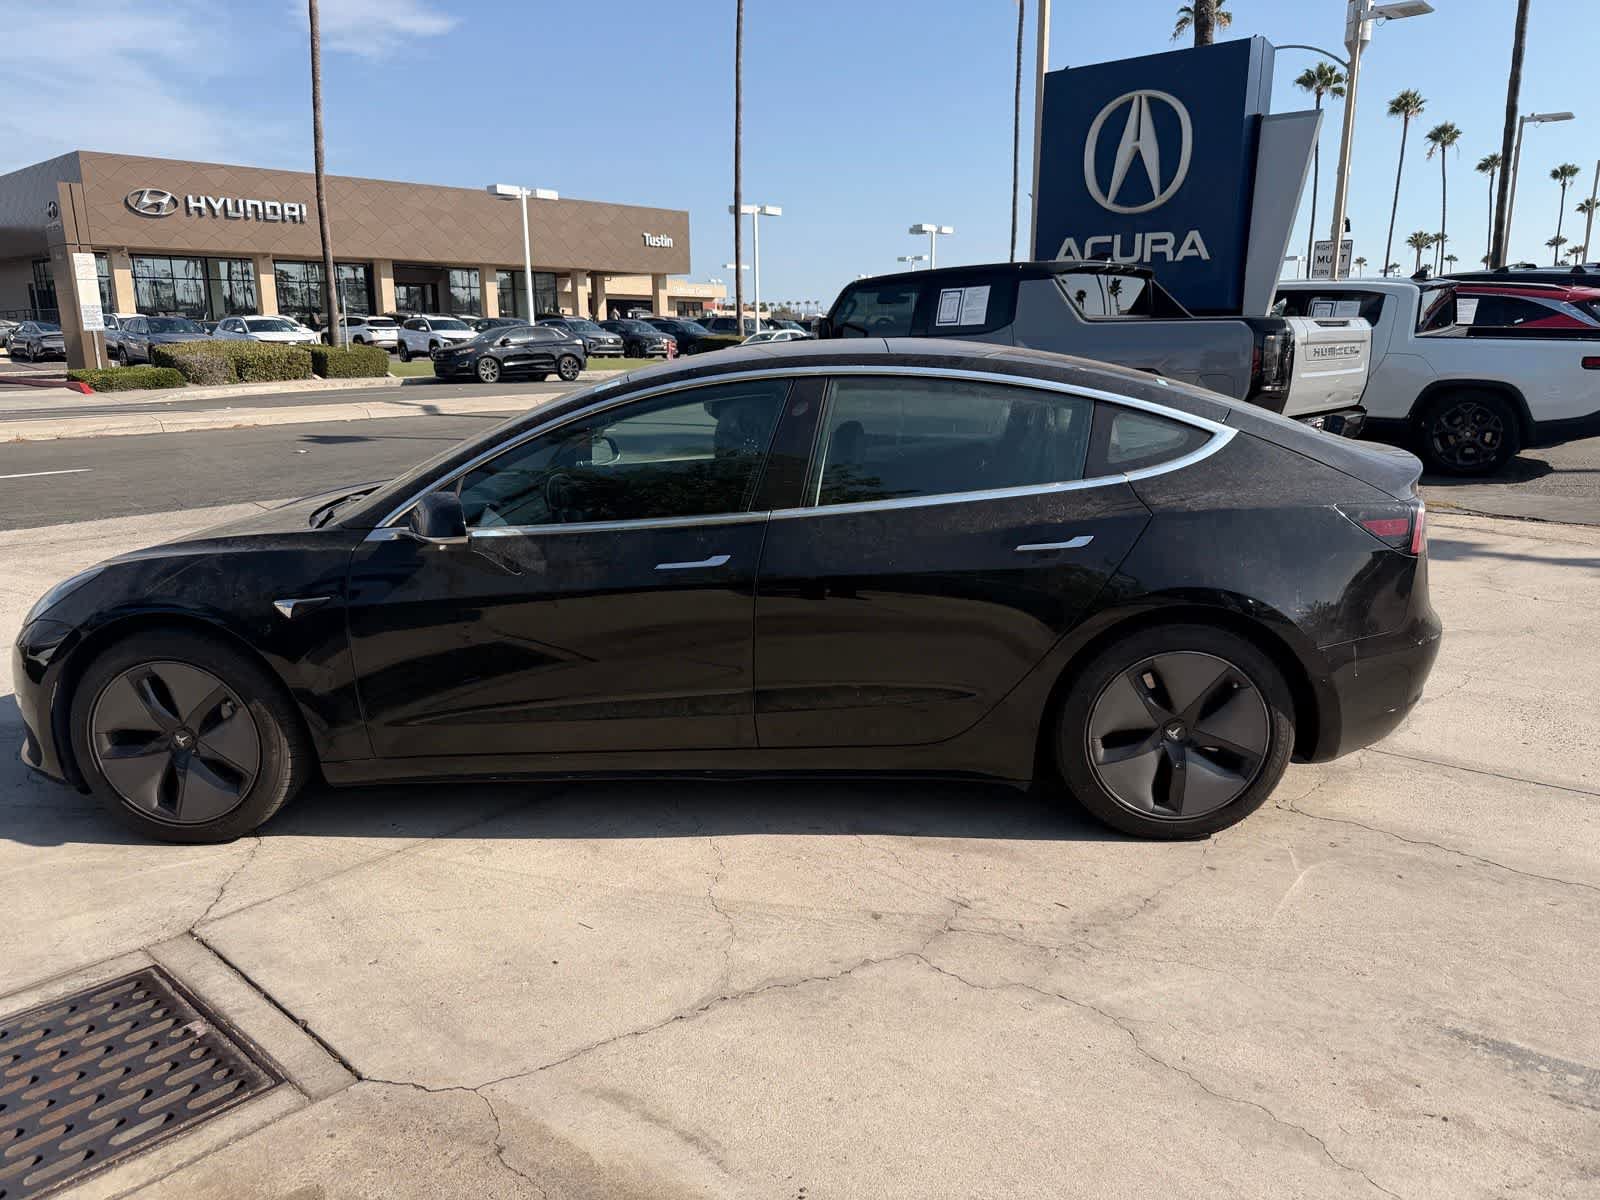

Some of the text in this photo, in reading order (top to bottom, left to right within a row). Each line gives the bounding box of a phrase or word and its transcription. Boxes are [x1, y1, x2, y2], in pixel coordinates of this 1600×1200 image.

[186, 194, 307, 223] HYUNDAI
[643, 232, 673, 248] Tustin
[1055, 230, 1211, 263] ACURA
[1316, 255, 1347, 264] MUT
